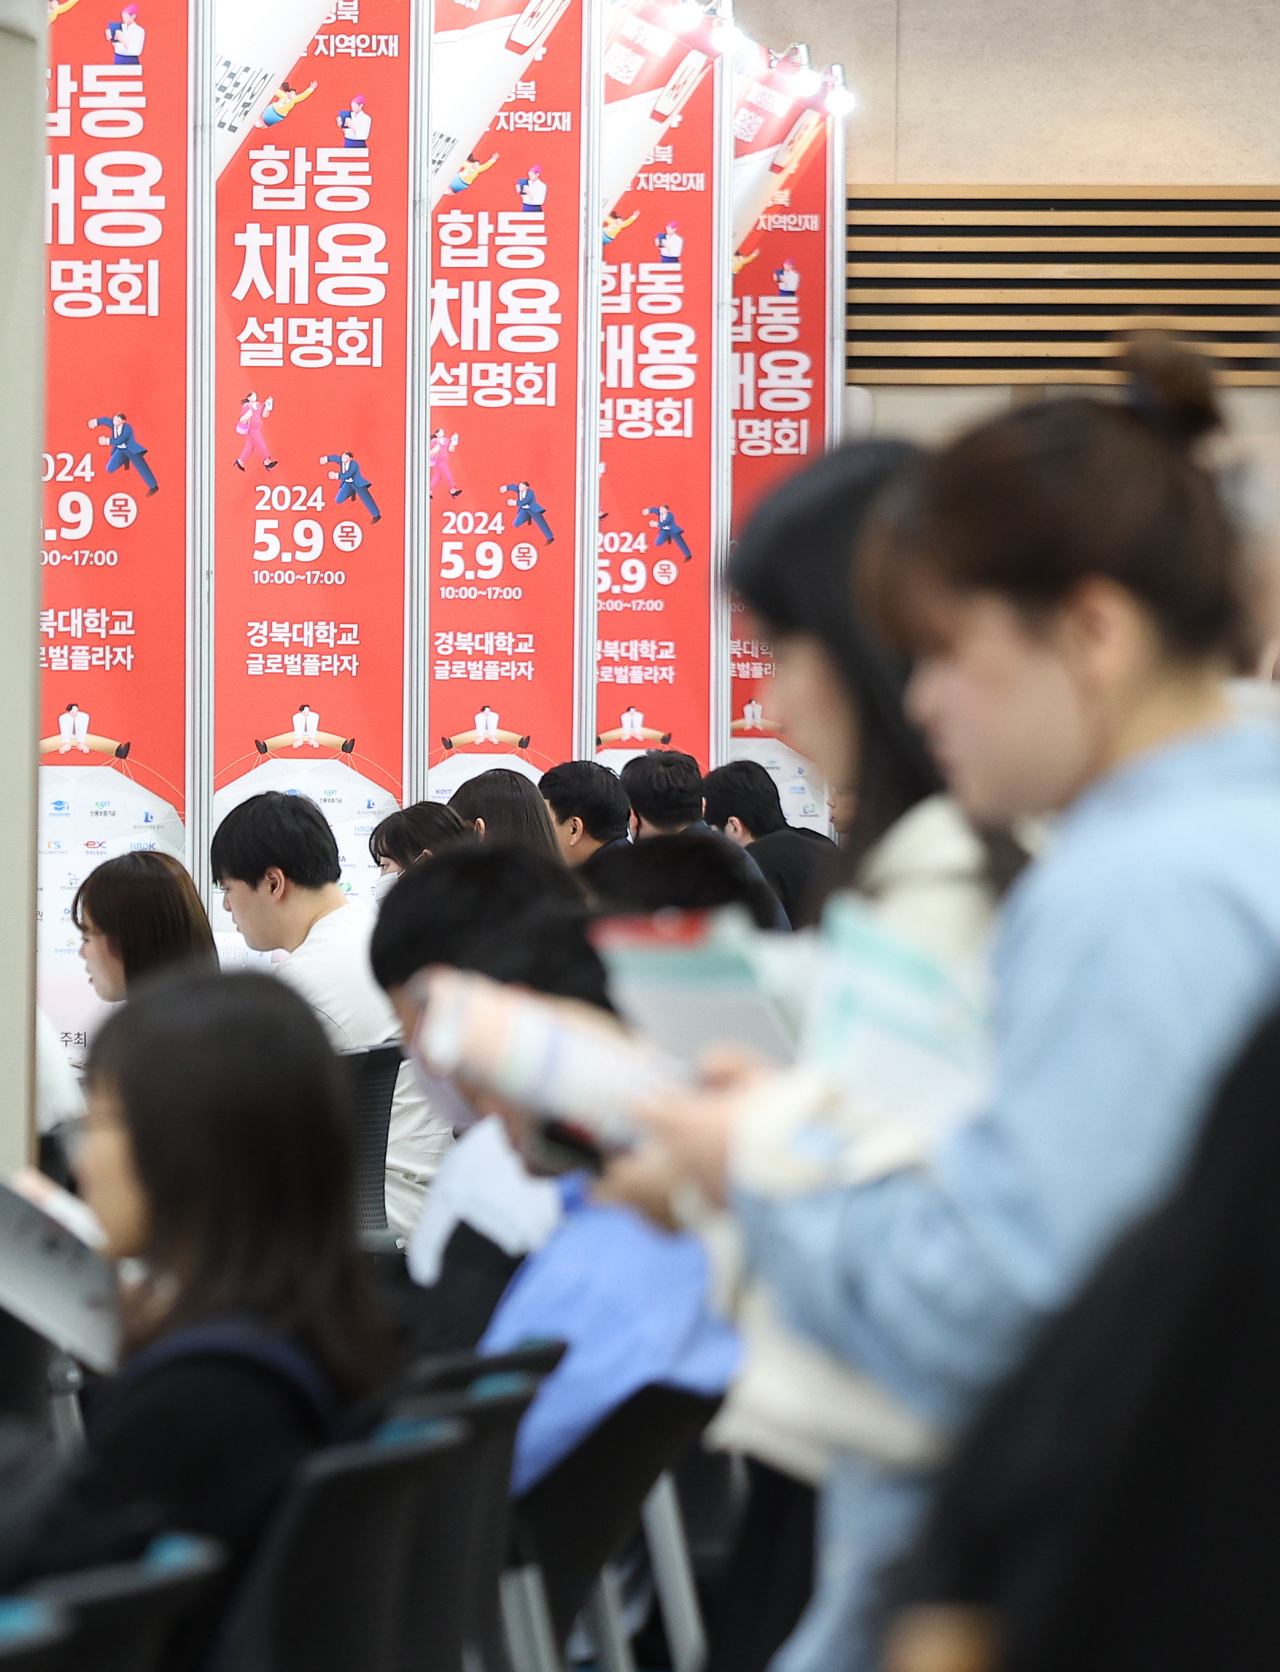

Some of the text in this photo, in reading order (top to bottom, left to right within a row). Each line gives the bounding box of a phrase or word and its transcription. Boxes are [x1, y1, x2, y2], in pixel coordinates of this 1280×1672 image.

[323, 0, 359, 24] 북
[314, 34, 399, 57] 지역인재
[504, 81, 536, 102] 북
[495, 111, 571, 132] 지역인재
[643, 145, 673, 165] 북
[248, 145, 373, 211] 합동
[636, 172, 706, 191] 지역인재
[757, 213, 819, 232] 지역인재
[437, 209, 548, 269] 합동
[231, 223, 389, 306] 채용
[51, 259, 159, 317] 명회
[430, 278, 562, 353] 채용
[236, 316, 383, 368] 설명회
[430, 362, 556, 407] 설명회
[732, 418, 808, 456] 명회
[42, 453, 95, 482] 024
[255, 485, 325, 512] 2024
[44, 491, 132, 541] .9 목
[441, 510, 505, 535] 2024
[252, 518, 360, 562] 5.9 목
[439, 541, 535, 581] 5.9 목
[655, 561, 675, 584] 목
[252, 569, 346, 585] 10:00~17:00
[439, 586, 522, 600] 10:00~17:00
[597, 599, 665, 612] 0:00~17:00
[40, 608, 135, 639] 북대학교
[246, 620, 360, 648] 경북대학교
[433, 631, 535, 656] 경북대학교
[597, 639, 676, 661] 북대학교
[40, 645, 134, 671] 벌플라자
[245, 653, 359, 676] 글로벌플라자
[433, 660, 534, 682] 글로벌플라자
[597, 665, 674, 685] 로벌플라자
[60, 1031, 87, 1047] 주최
